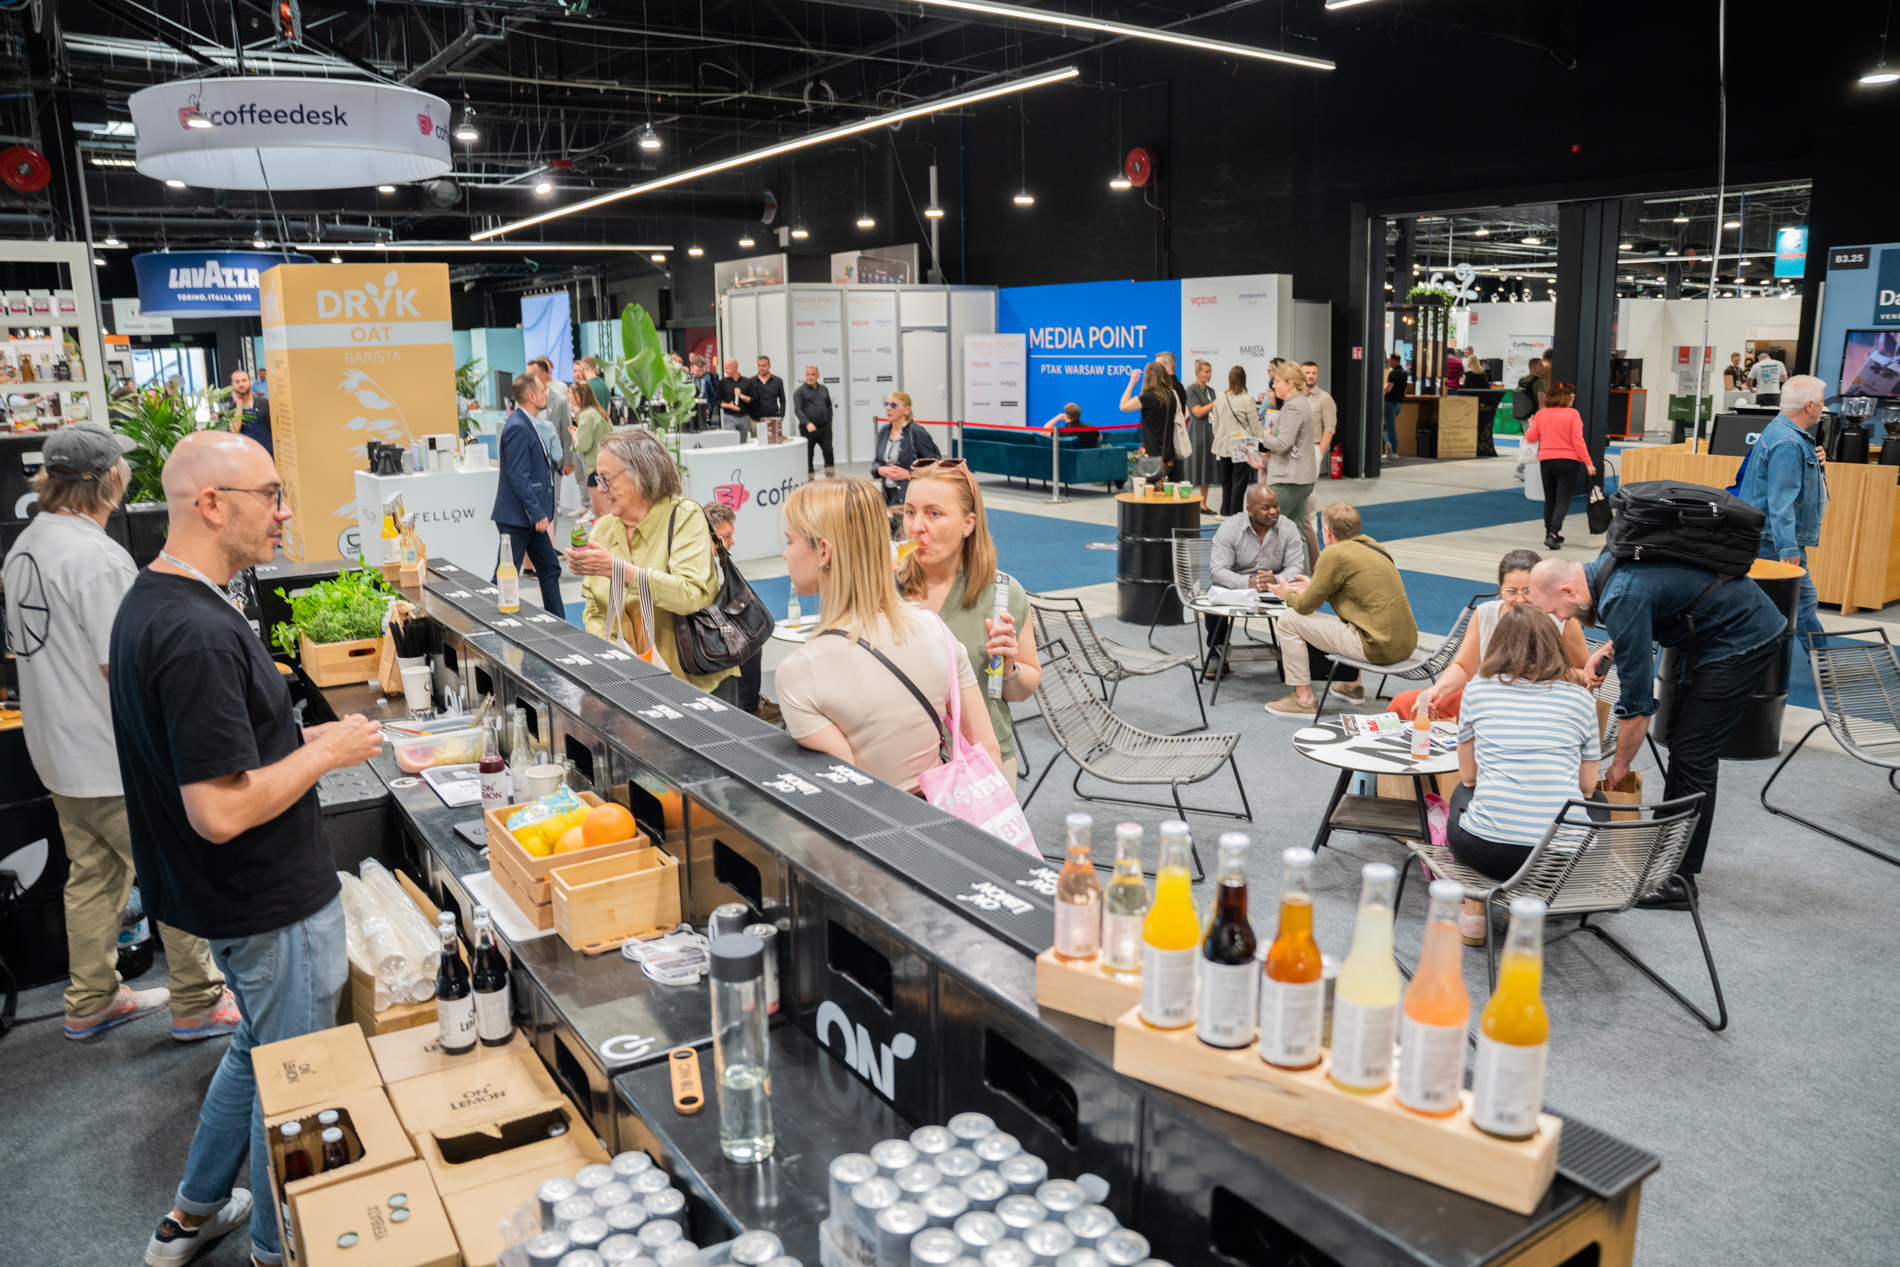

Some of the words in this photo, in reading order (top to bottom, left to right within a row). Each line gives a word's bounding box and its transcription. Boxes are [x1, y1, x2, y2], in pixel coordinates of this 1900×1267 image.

[211, 103, 348, 127] coffeedesk
[1835, 254, 1864, 263] B3.25
[168, 260, 260, 289] LAVAZZA
[316, 288, 421, 319] DRYK
[1190, 296, 1218, 307] wprost
[351, 326, 393, 342] OAT
[1029, 327, 1085, 349] MEDIA
[1089, 325, 1147, 349] POINT
[345, 350, 402, 364] BARISTA
[1240, 346, 1265, 354] BARISTA
[1040, 364, 1062, 375] PTAK
[1064, 364, 1105, 376] WARSAW
[1107, 365, 1132, 376] EXPO
[413, 508, 475, 523] FELLOW
[450, 1090, 506, 1110] LEMON
[463, 1087, 488, 1099] ON
